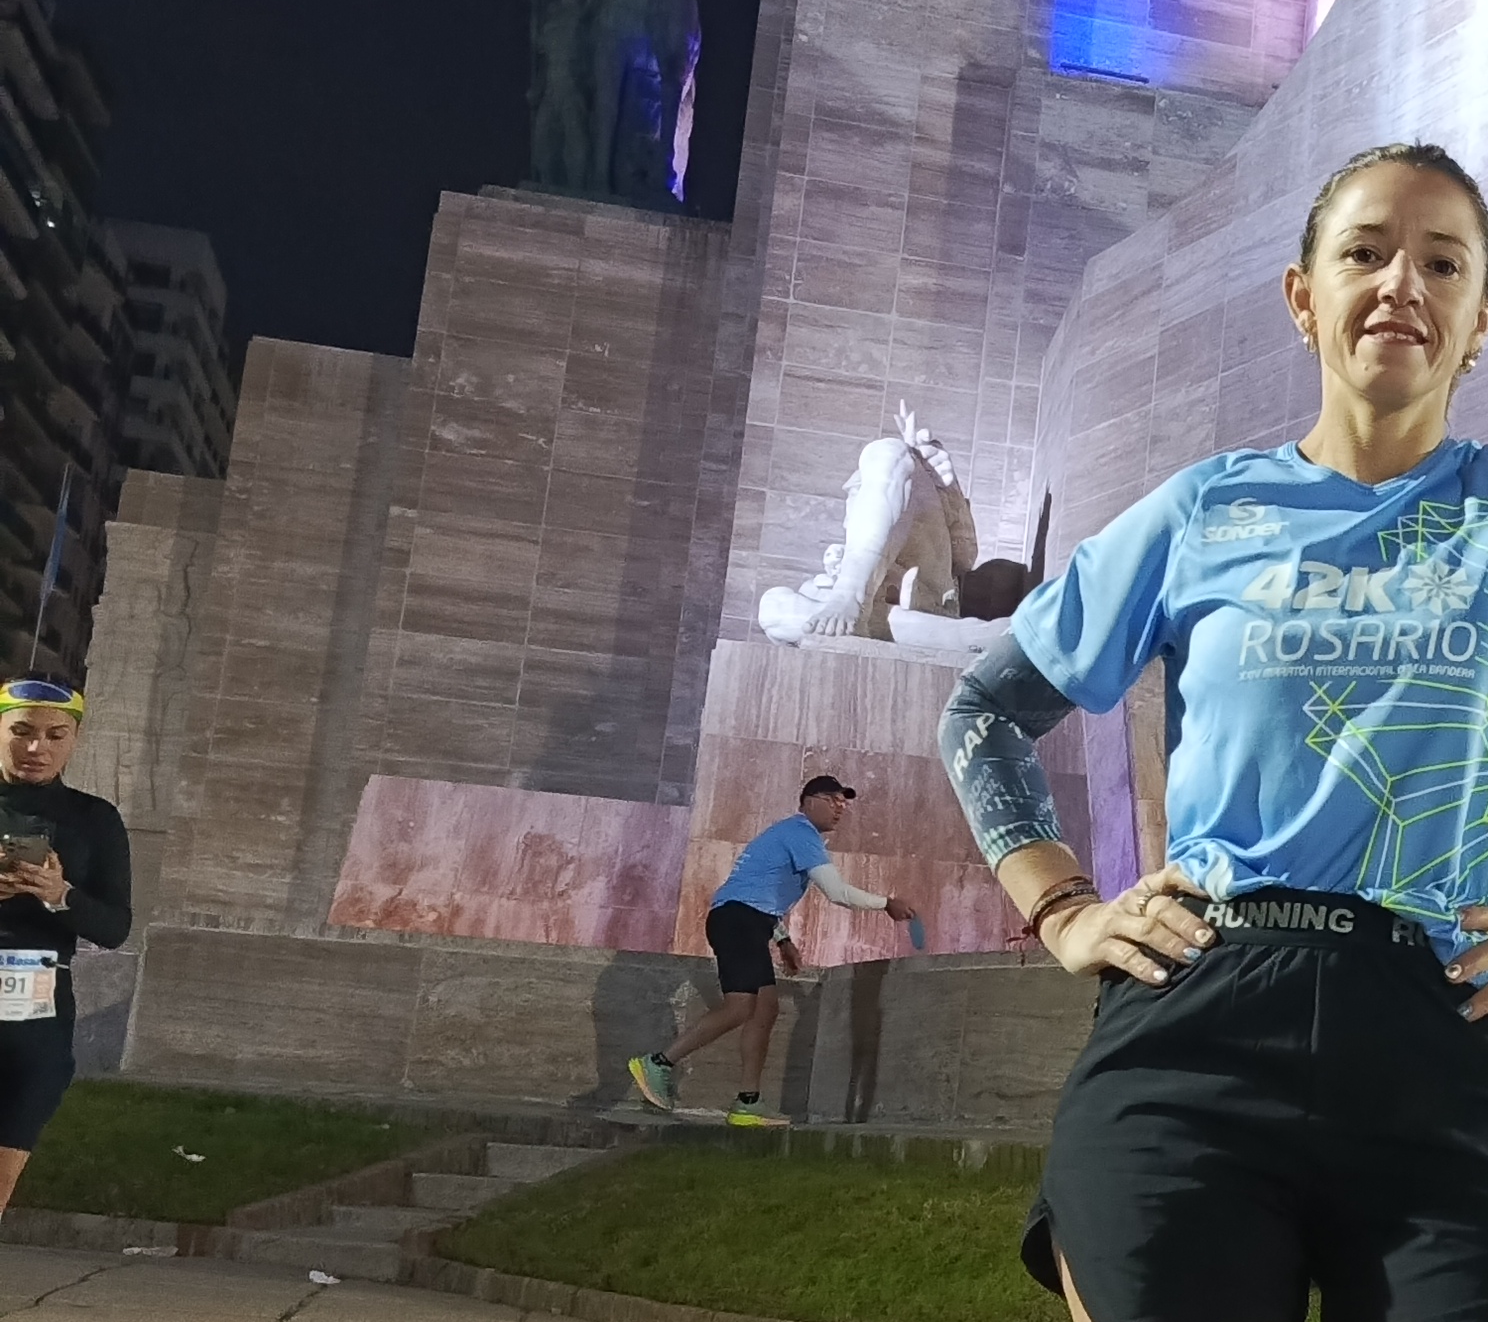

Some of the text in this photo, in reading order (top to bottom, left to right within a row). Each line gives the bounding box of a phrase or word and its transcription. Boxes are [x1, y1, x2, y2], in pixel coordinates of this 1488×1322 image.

[1241, 560, 1397, 613] 42K
[1239, 618, 1478, 666] ROSARIO
[952, 712, 996, 782] RAP
[1203, 902, 1356, 934] RUNNING
[0, 976, 26, 994] 91
